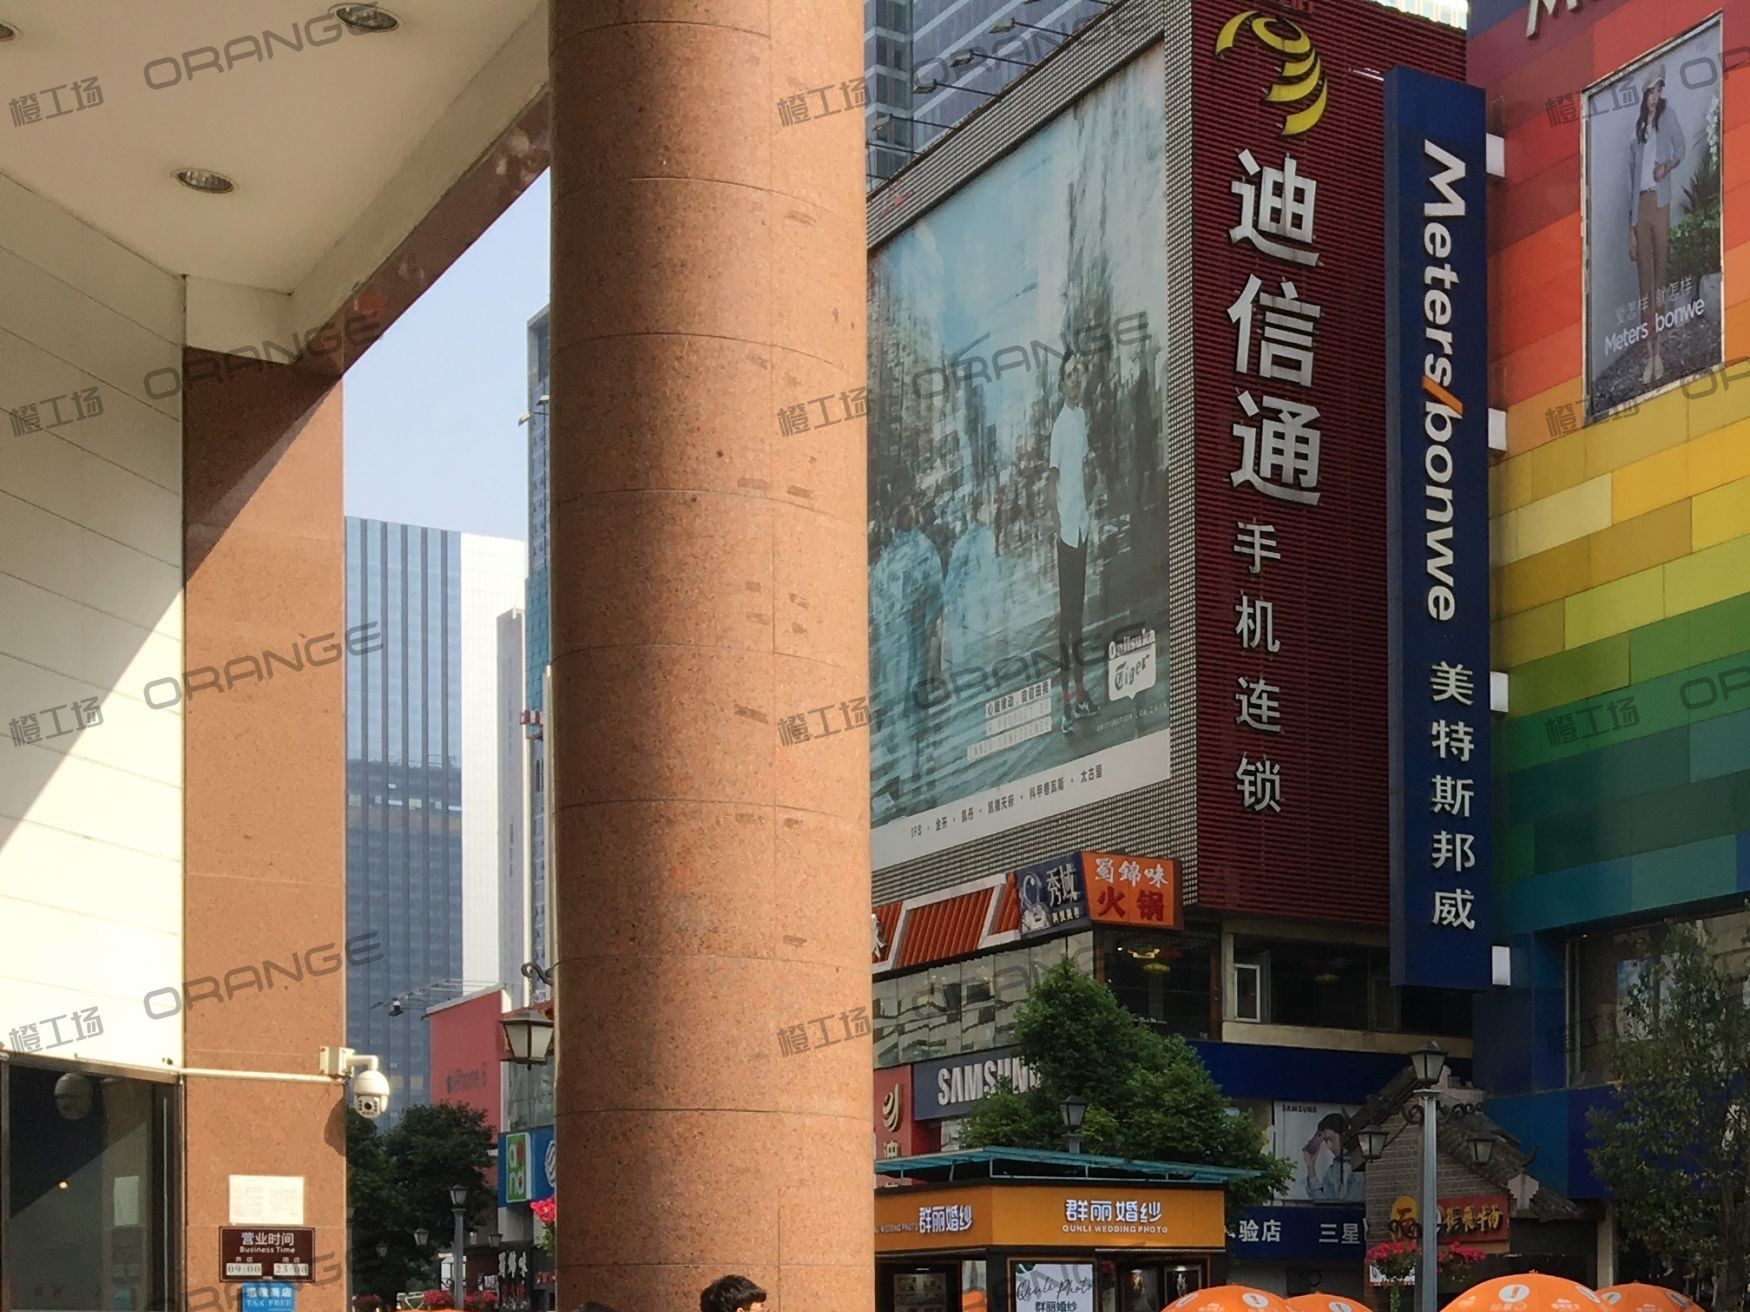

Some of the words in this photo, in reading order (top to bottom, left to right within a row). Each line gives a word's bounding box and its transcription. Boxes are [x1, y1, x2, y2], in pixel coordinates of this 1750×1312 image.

[1227, 148, 1322, 506] 迪信通
[1422, 139, 1466, 622] Meters/bonwe
[1233, 520, 1282, 814] 手机连锁
[1429, 660, 1476, 931] 美特斯邦威
[1097, 885, 1164, 921] 火锅
[919, 1205, 973, 1234] 群丽婚纱
[1065, 1199, 1163, 1223] 群丽婚纱
[241, 1232, 295, 1246] 营业时间
[1062, 1224, 1092, 1233] QUNLI
[1094, 1225, 1136, 1233] WEDDING
[1137, 1225, 1169, 1234] PHOTO
[239, 1246, 274, 1254] Business
[276, 1246, 296, 1254] Time
[227, 1263, 261, 1274] 09:00
[246, 1299, 265, 1307] TAX
[268, 1299, 292, 1307] FREE
